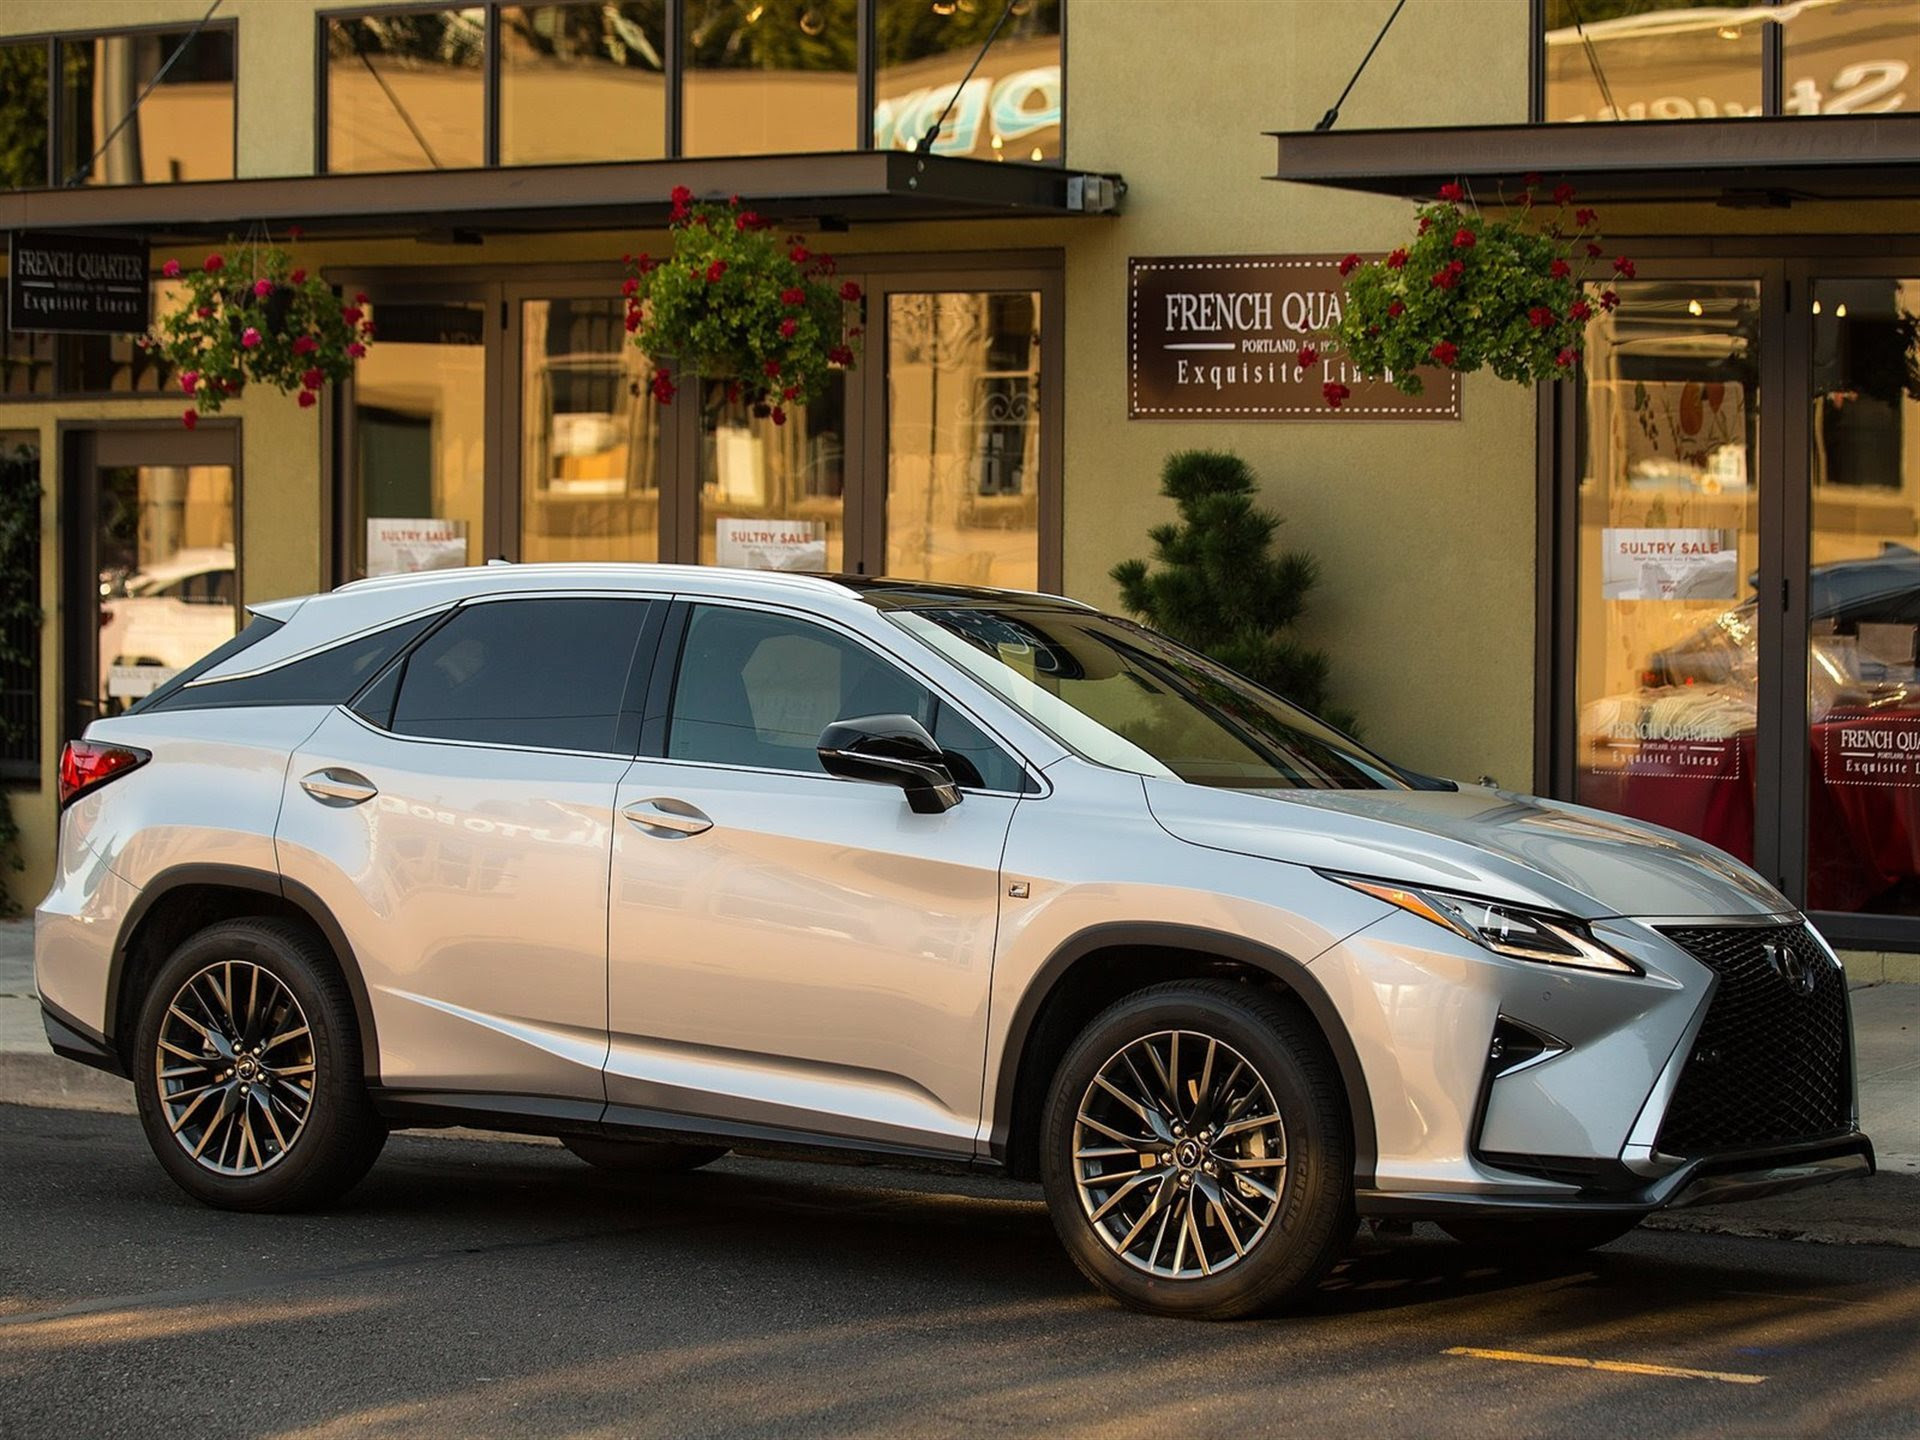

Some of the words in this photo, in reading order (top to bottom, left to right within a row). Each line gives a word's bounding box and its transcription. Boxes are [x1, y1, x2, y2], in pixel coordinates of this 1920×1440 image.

[18, 249, 74, 277] FRENCH
[77, 253, 143, 281] QUARTER
[23, 291, 88, 314] Exquisite
[96, 295, 138, 313] Linens
[1165, 292, 1272, 332] FRENCH
[1177, 359, 1303, 390] Exquisite
[381, 530, 420, 542] SULTRY
[426, 531, 454, 543] SALE
[731, 531, 775, 544] SULTRY
[780, 532, 811, 544] SALE
[1619, 542, 1676, 555] SULTRY
[1681, 542, 1720, 555] SALE
[1606, 722, 1657, 740] FRENCH
[1661, 723, 1724, 743] QUARTER
[1841, 729, 1893, 749] FRENCH
[1612, 750, 1672, 765] Exquisite
[1679, 753, 1719, 767] Linens
[1846, 759, 1907, 775] Exquisite
